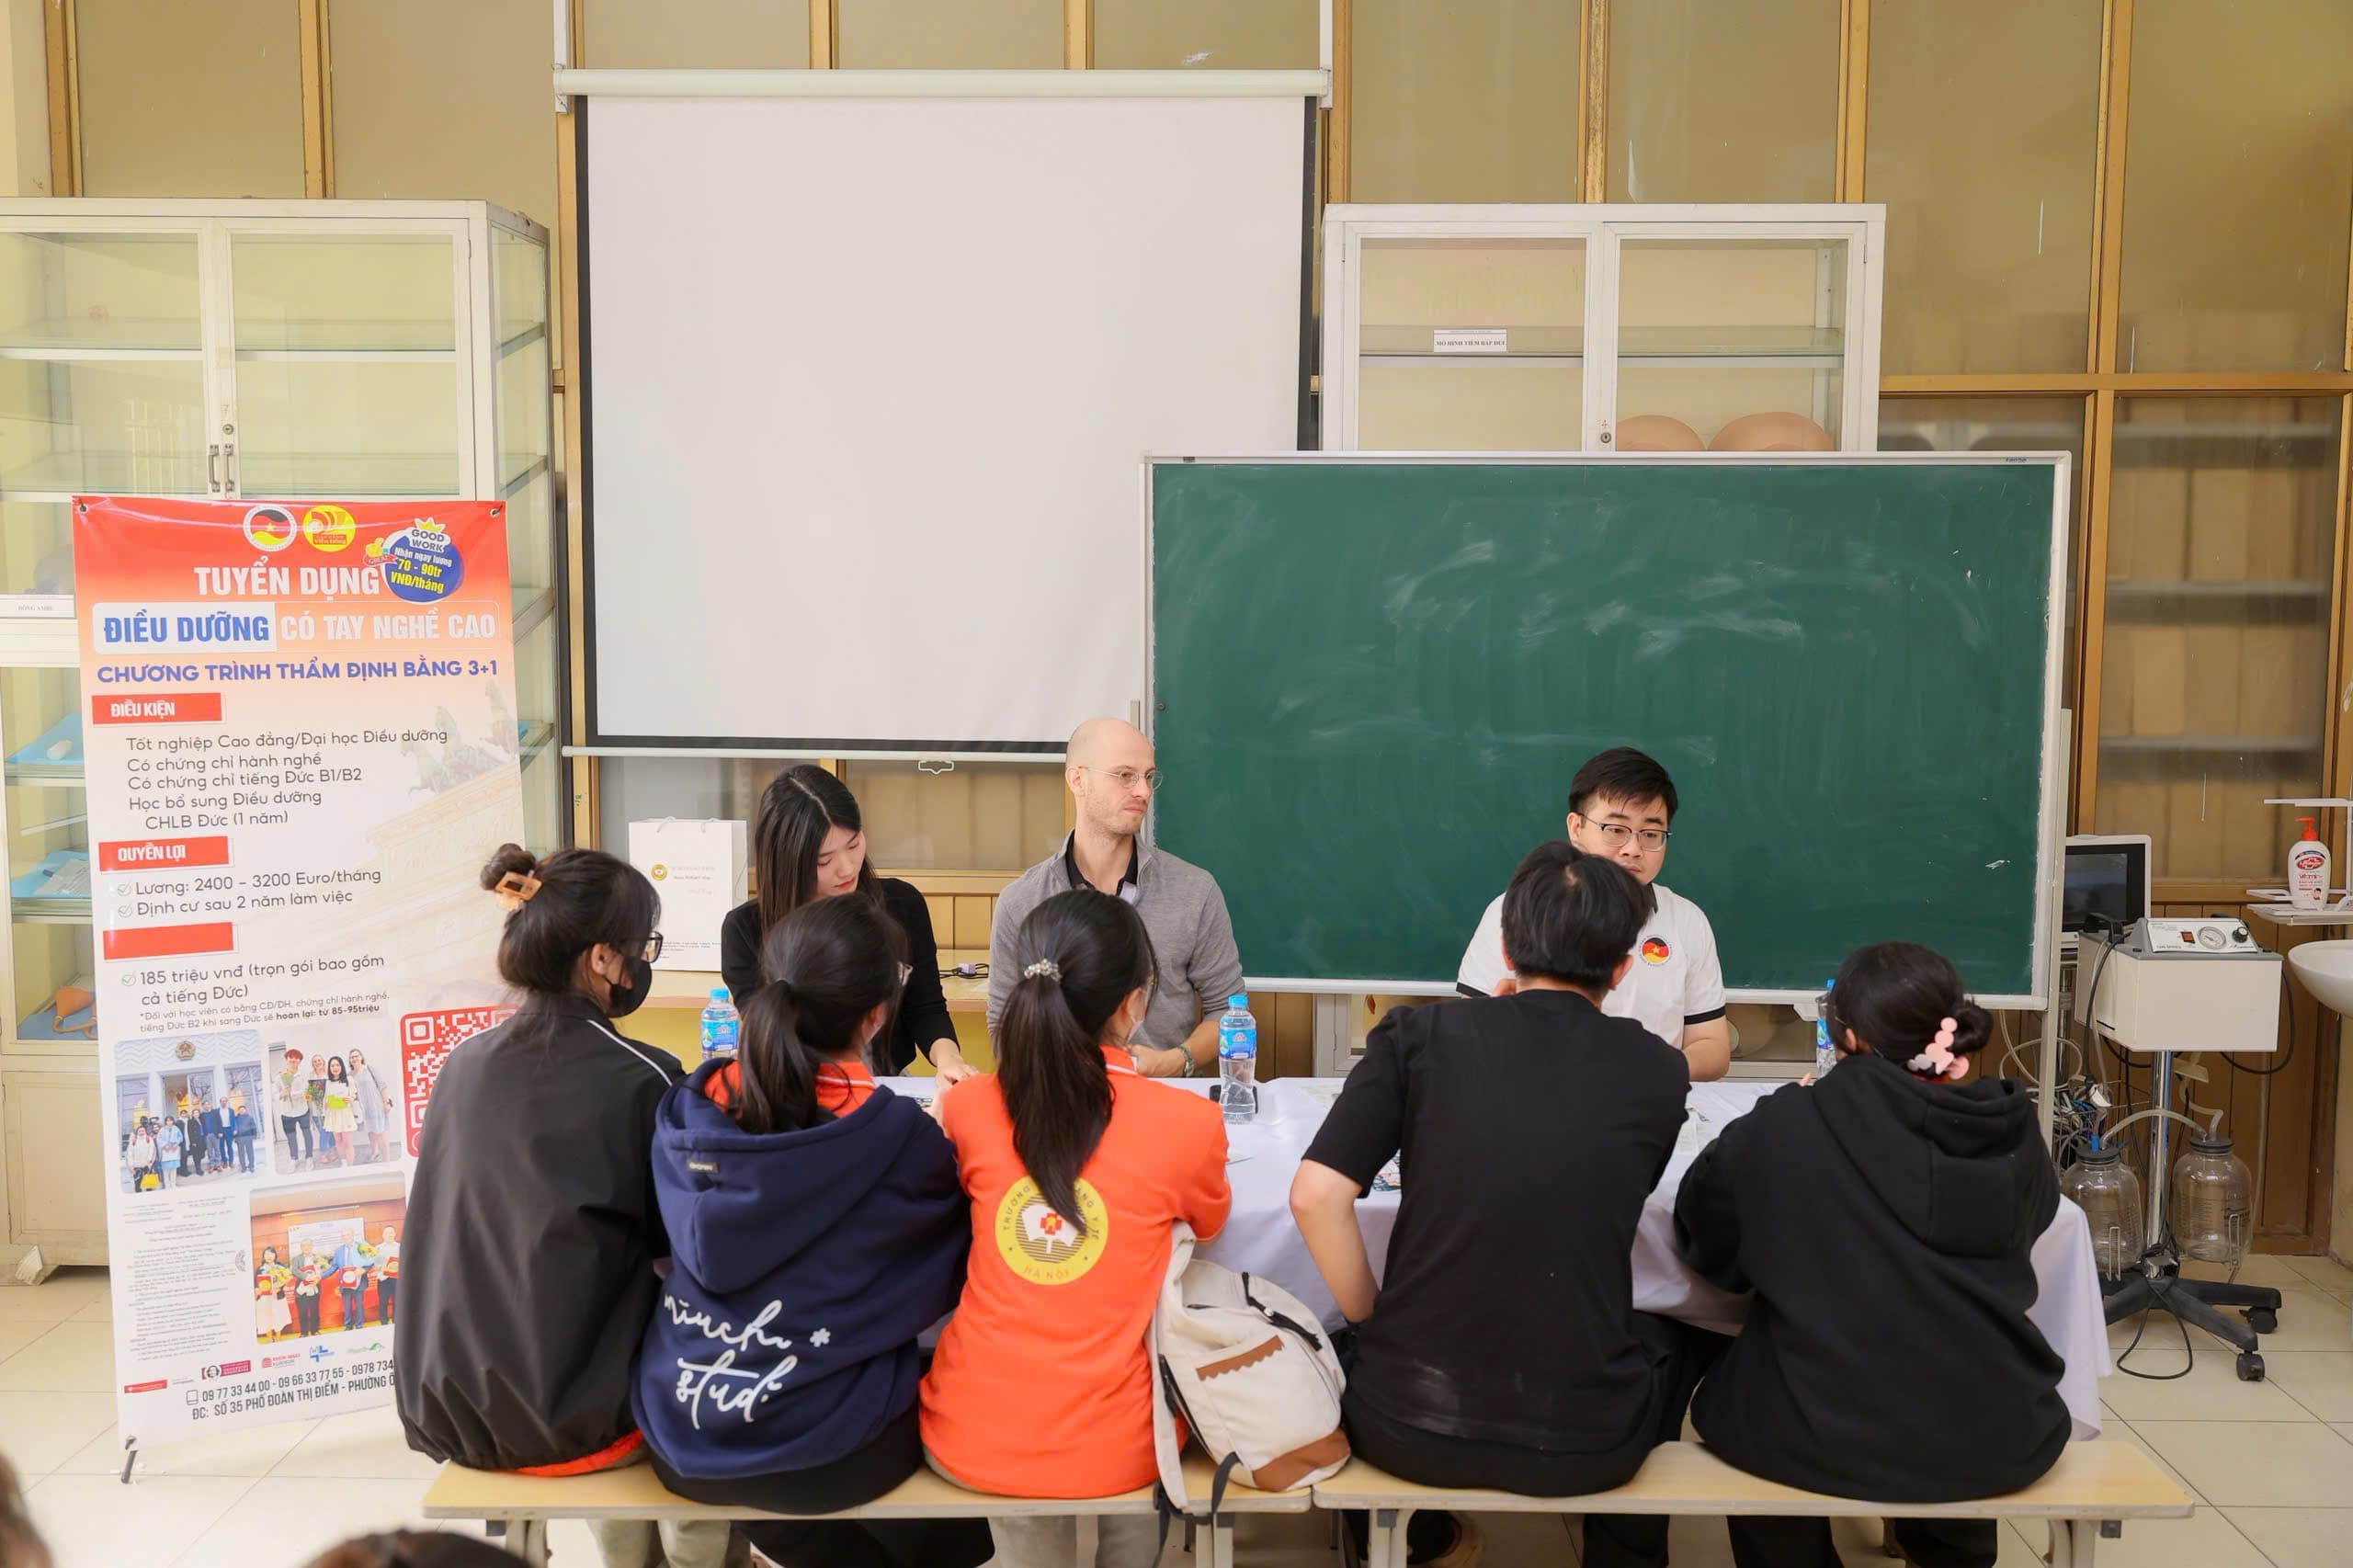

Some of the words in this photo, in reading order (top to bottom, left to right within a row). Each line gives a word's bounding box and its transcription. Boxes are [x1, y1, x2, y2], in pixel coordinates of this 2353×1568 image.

[412, 529, 445, 542] GOOD
[412, 539, 443, 551] WORK
[194, 555, 290, 596] TUYỂN
[300, 567, 381, 601] DỤNG
[397, 558, 412, 572] 70
[421, 562, 443, 578] 90tr
[391, 571, 445, 595] VNĐ/tháng
[104, 608, 167, 642] ĐIỀU
[177, 610, 269, 642] DƯỠNG
[280, 610, 315, 641] CÓ
[324, 615, 364, 641] TAY
[373, 607, 441, 640] NGHỀ
[448, 614, 496, 639] CAO
[97, 664, 199, 683] CHƯƠNG
[204, 660, 271, 681] TRÌNH
[276, 656, 340, 679] THẨM
[347, 662, 397, 681] ĐỊNH
[404, 653, 462, 677] BẰNG
[468, 660, 497, 676] 3+1
[110, 699, 142, 718] ĐIỀU
[143, 699, 176, 720] KIỆN
[126, 735, 153, 751] Tốt
[158, 736, 213, 754] nghiệp
[218, 734, 251, 748] Cao
[332, 732, 358, 746] học
[402, 729, 449, 744] dưỡng
[127, 758, 151, 772] Có
[156, 757, 206, 773] chứng
[211, 755, 234, 769] chỉ
[239, 754, 278, 767] hành
[128, 776, 152, 790] Có
[157, 775, 208, 791] chứng
[212, 773, 234, 787] chỉ
[240, 771, 280, 788] tiếng
[285, 770, 315, 784] Đức
[320, 767, 362, 782] B1/B2
[129, 797, 160, 812] Học
[165, 793, 186, 809] bổ
[191, 797, 228, 810] sung
[273, 790, 322, 806] dưỡng
[145, 814, 192, 830] CHLB
[198, 813, 228, 827] Đức
[233, 812, 244, 825] (1
[249, 810, 289, 825] năm)
[118, 842, 164, 861] QUYỀN
[165, 844, 187, 862] LỢI
[136, 881, 189, 897] Lương:
[194, 876, 233, 892] 2400
[252, 873, 290, 888] 3200
[296, 869, 381, 884] Euro/tháng
[137, 900, 175, 917] Định
[179, 901, 200, 913] cư
[205, 900, 232, 911] sau
[236, 895, 246, 909] 2
[251, 895, 286, 908] năm
[290, 892, 318, 905] làm
[323, 890, 354, 905] việc
[140, 971, 167, 985] 185
[172, 969, 209, 983] triệu
[213, 964, 244, 979] vnđ
[249, 963, 285, 978] (trọn
[290, 960, 313, 977] gói
[318, 958, 347, 971] bao
[142, 992, 161, 1006] cả
[166, 988, 208, 1005] tiếng
[212, 984, 248, 1000] Đức)
[202, 1389, 214, 1403] 09
[216, 1387, 228, 1399] 77
[231, 1384, 243, 1397] 33
[244, 1382, 256, 1394] 44
[258, 1380, 270, 1392] 00
[278, 1376, 290, 1389] 09
[290, 1373, 304, 1386] 66
[305, 1371, 317, 1383] 33
[319, 1369, 331, 1381] 77
[332, 1367, 345, 1379] 55
[351, 1362, 375, 1376] 0978
[192, 1406, 210, 1420] ĐC:
[214, 1399, 229, 1416] SỐ
[230, 1400, 244, 1414] 35
[245, 1392, 267, 1411] PHỐ
[267, 1390, 295, 1407] ĐOÀN
[296, 1388, 313, 1402] THỊ
[314, 1379, 339, 1398] ĐIỂM
